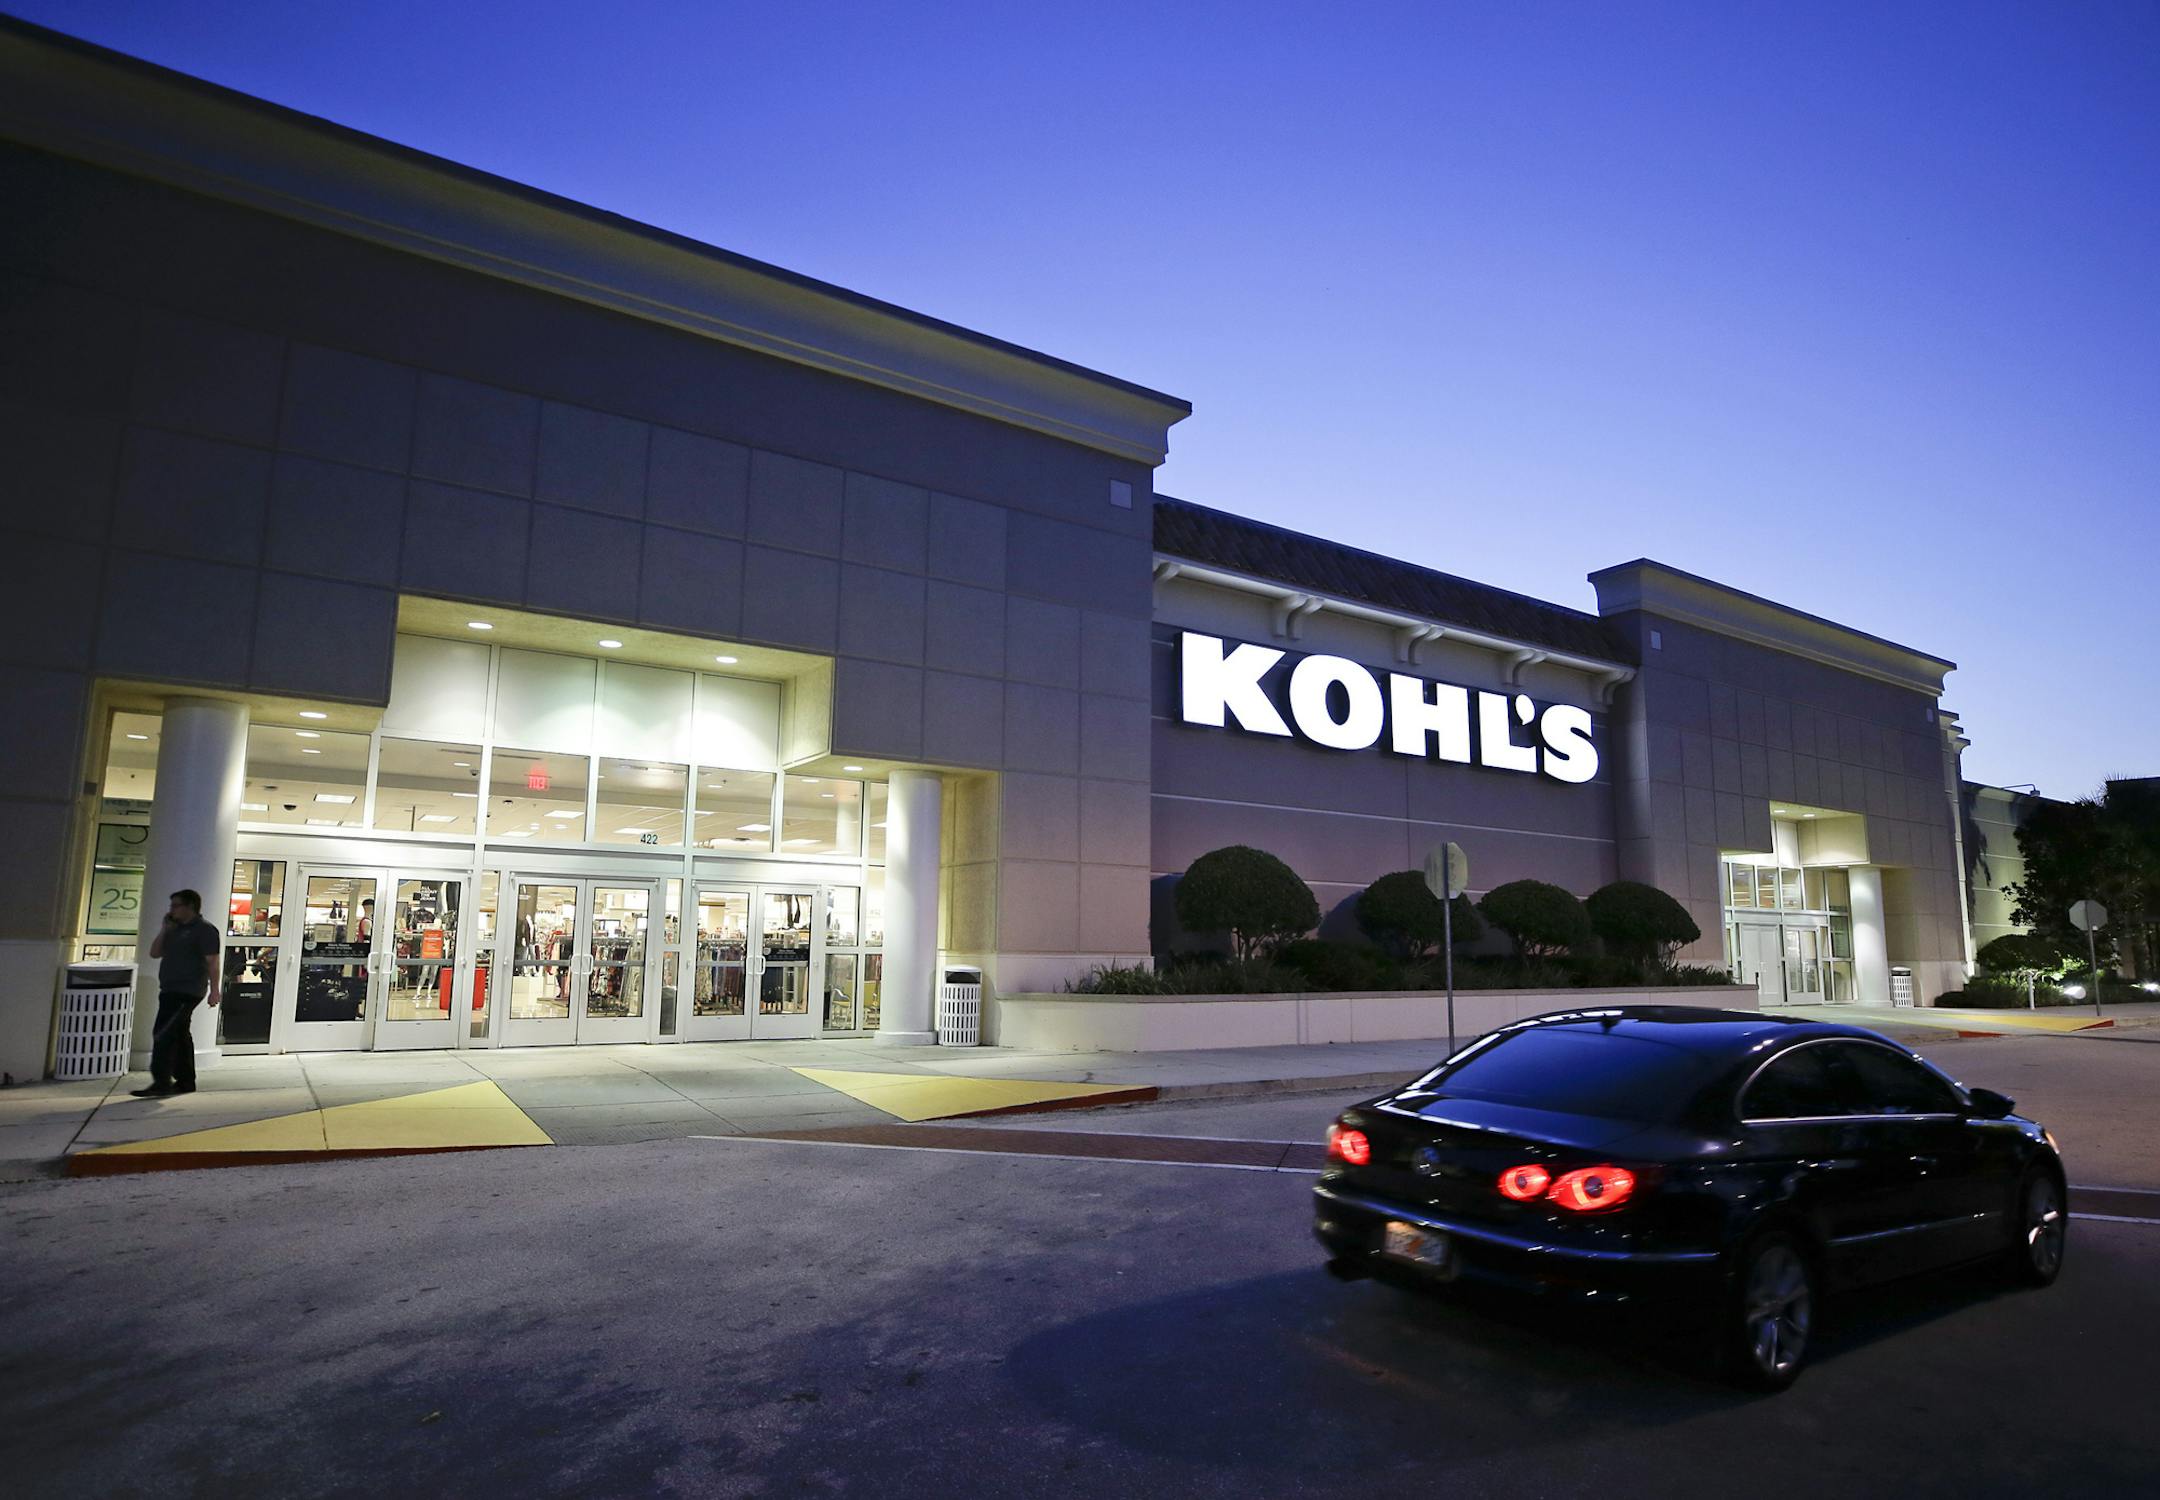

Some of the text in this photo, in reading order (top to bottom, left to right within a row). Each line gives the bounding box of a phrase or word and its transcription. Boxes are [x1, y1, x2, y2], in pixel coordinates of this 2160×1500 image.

[1181, 631, 1599, 783] KOHL'S
[640, 833, 658, 845] 422
[100, 888, 138, 911] 25
